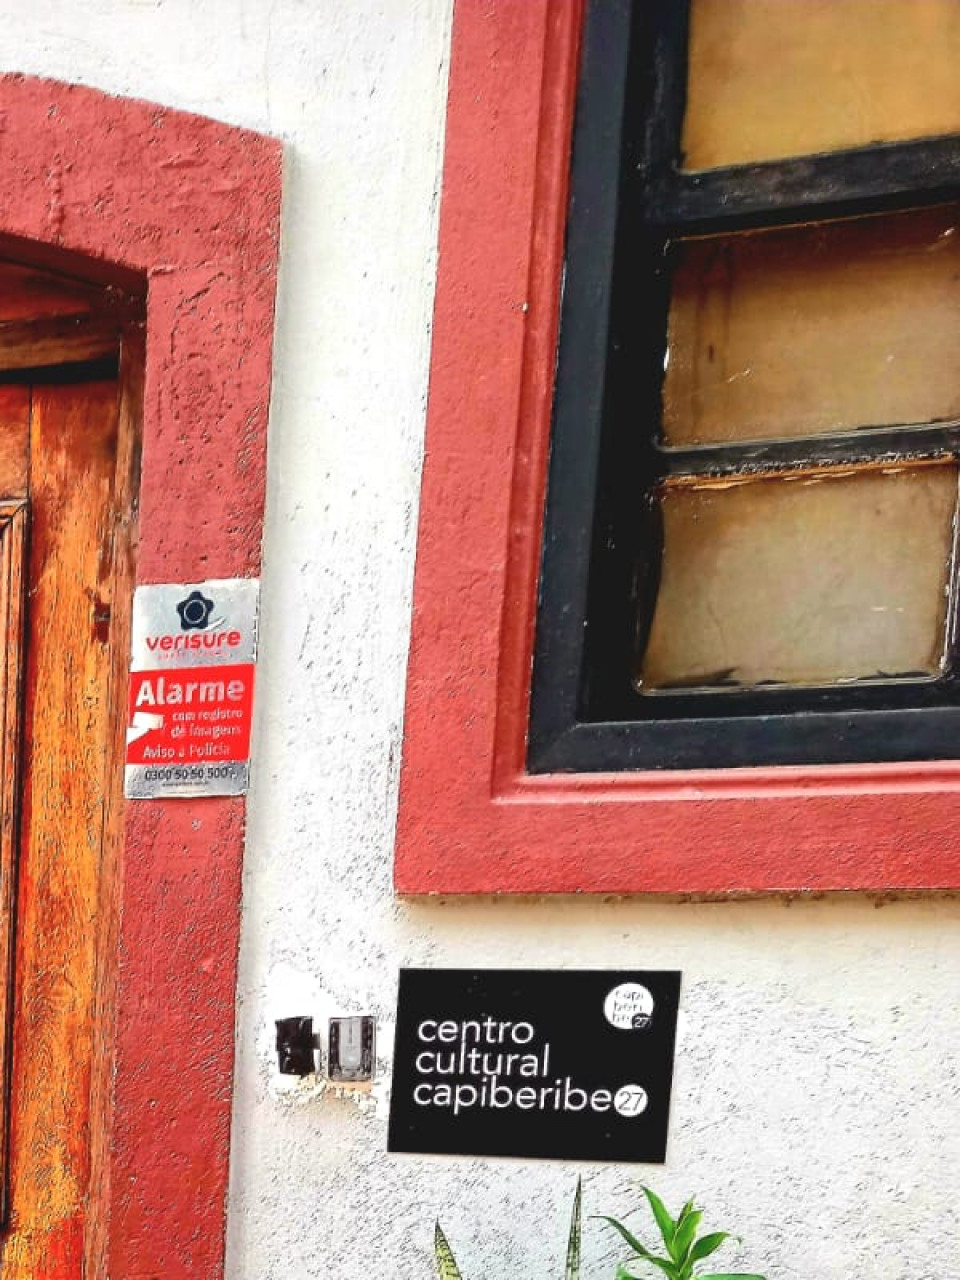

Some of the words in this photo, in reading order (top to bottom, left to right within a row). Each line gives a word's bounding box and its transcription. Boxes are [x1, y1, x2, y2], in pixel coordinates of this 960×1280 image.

[146, 629, 241, 651] verisure
[136, 677, 245, 706] Alarme
[143, 744, 174, 759] Aviso
[417, 1016, 535, 1045] centro
[415, 1042, 551, 1077] cultural
[413, 1074, 613, 1116] capiberibe
[618, 1091, 645, 1111] 27
